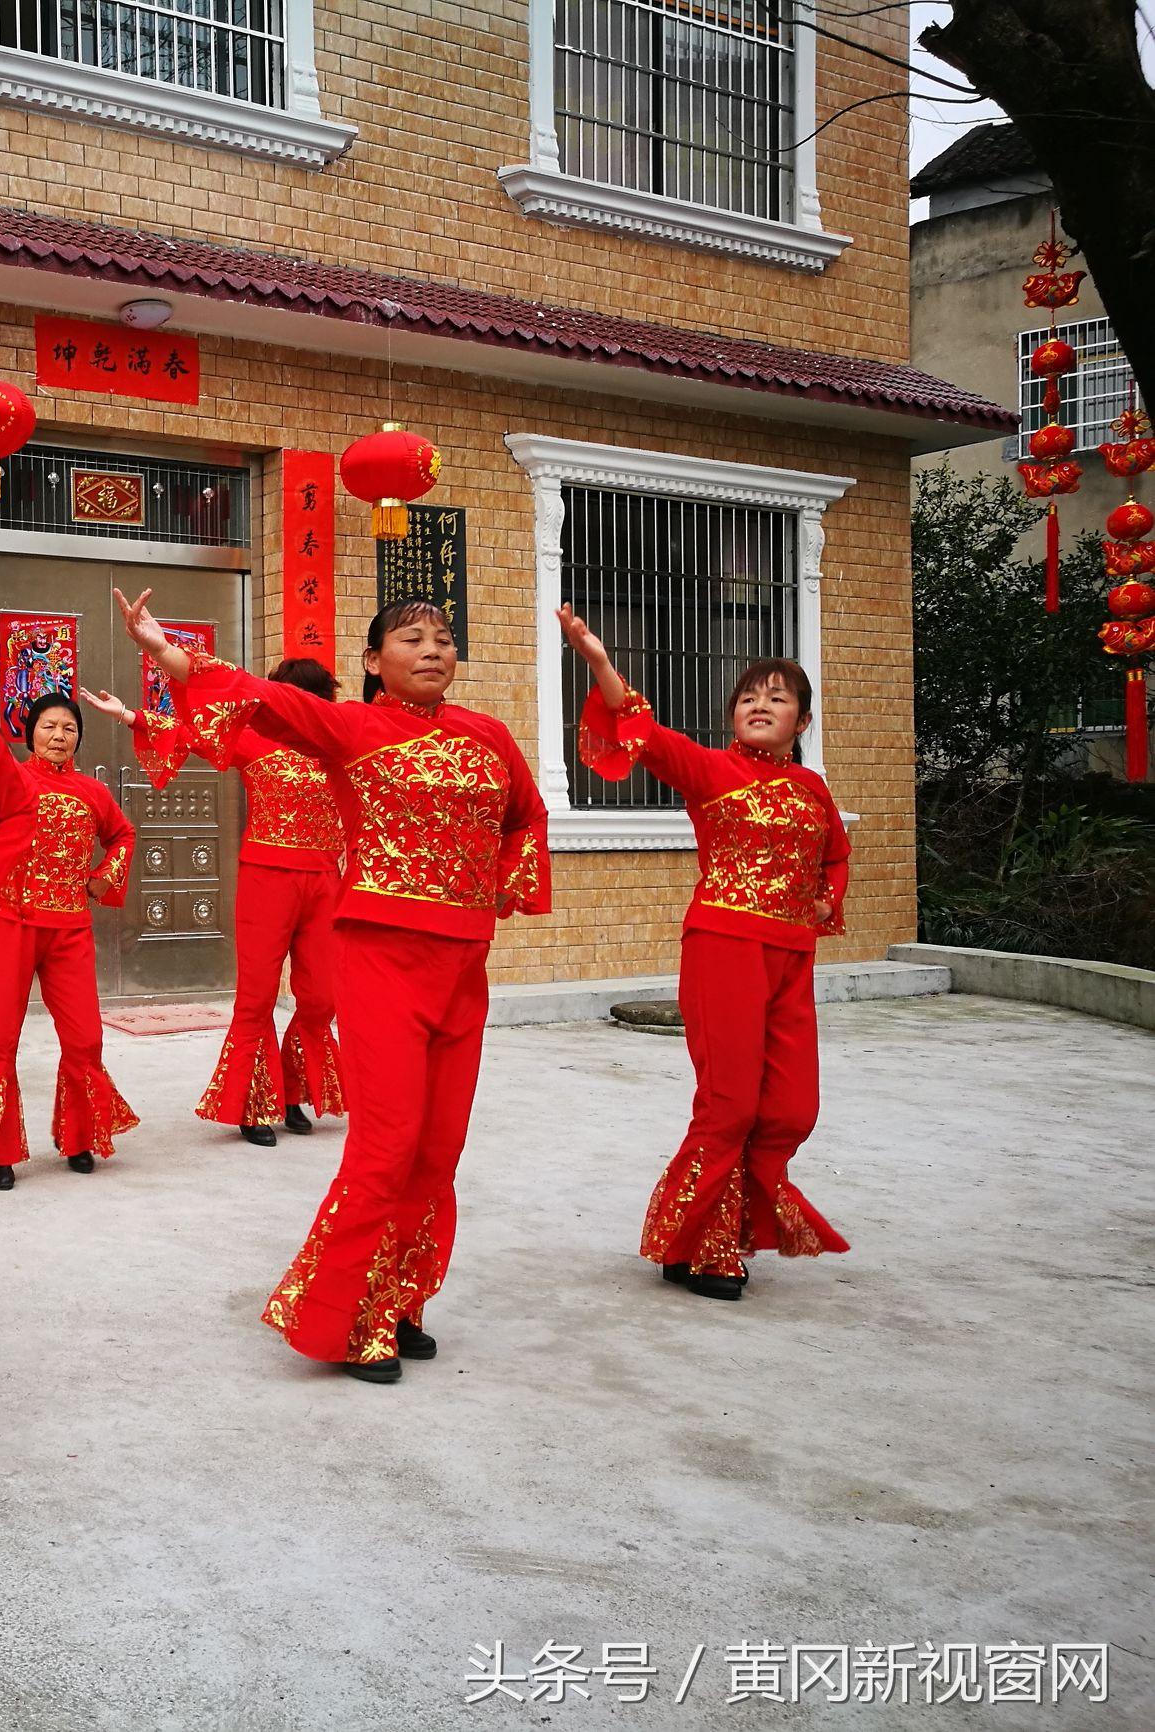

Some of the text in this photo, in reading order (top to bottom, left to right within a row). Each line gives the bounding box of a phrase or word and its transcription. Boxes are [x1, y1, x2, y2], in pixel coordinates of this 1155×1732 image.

[97, 483, 118, 509] 福
[437, 511, 459, 652] 何存中書
